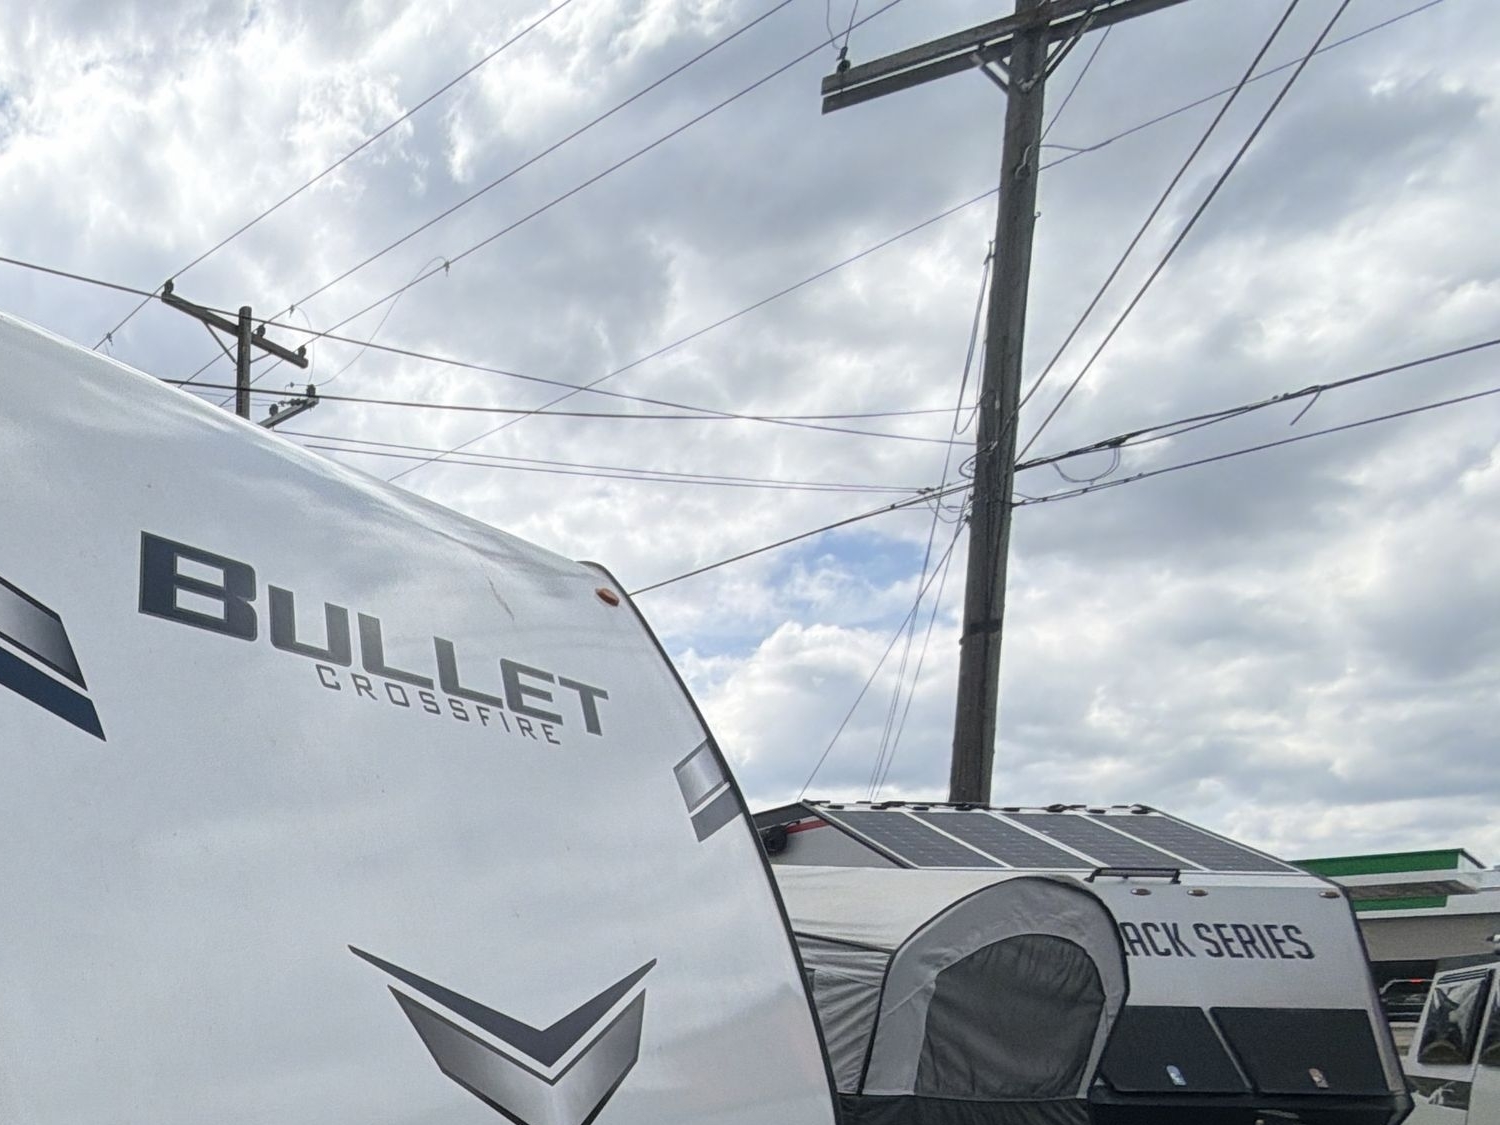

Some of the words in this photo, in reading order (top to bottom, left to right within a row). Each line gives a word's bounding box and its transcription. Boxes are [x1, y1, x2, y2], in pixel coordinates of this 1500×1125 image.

[137, 530, 609, 737] BULLET
[315, 664, 562, 745] CROSSFIRE
[1118, 922, 1196, 957] ACK
[1192, 922, 1315, 959] SERIES
